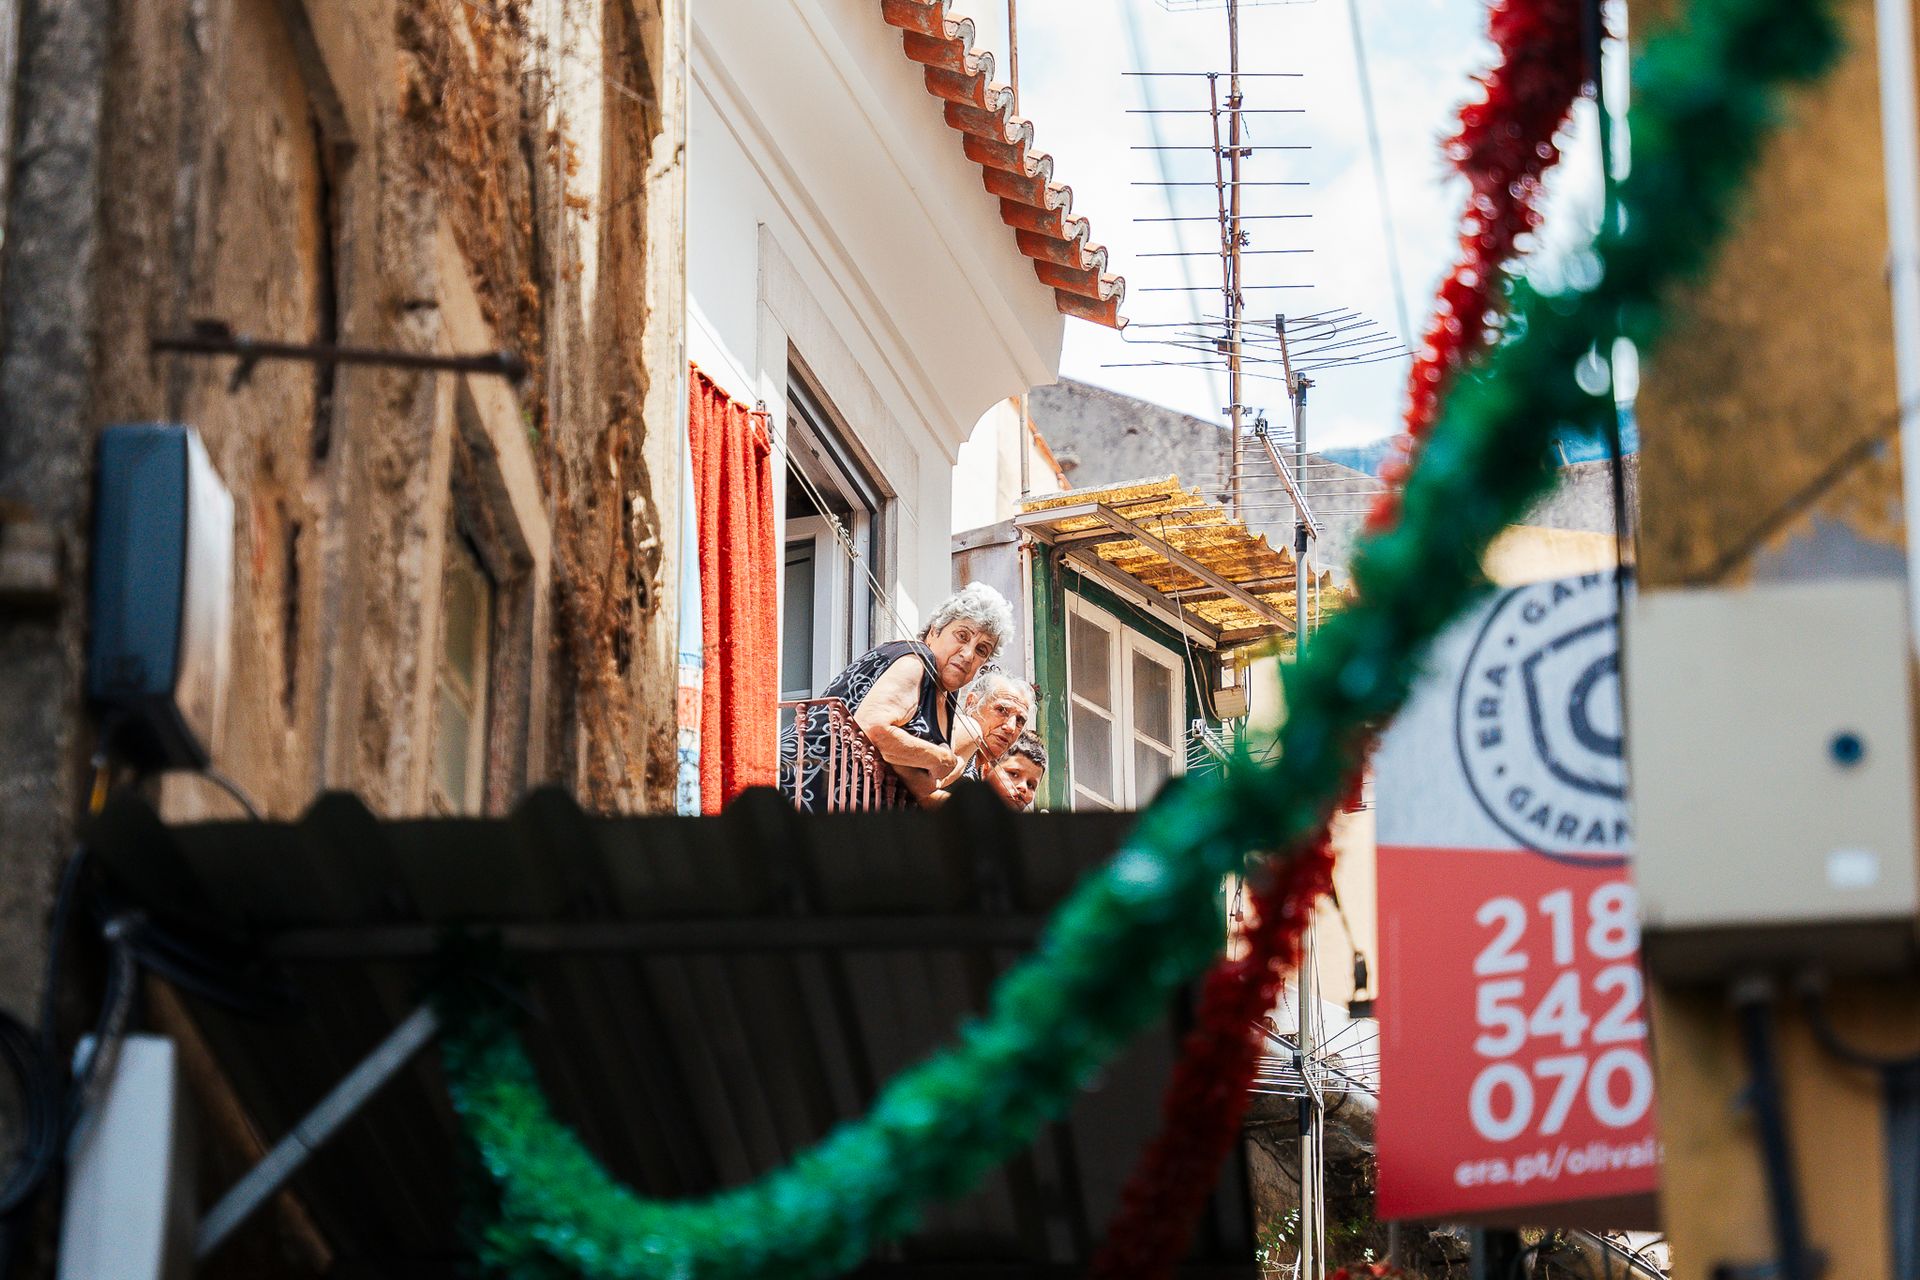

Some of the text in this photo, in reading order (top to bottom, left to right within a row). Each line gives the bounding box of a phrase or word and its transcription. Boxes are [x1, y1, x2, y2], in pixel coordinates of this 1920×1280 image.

[1477, 662, 1507, 749] ERA
[1474, 882, 1641, 977] 218
[1474, 964, 1647, 1058] 542
[1468, 1048, 1654, 1142] 070
